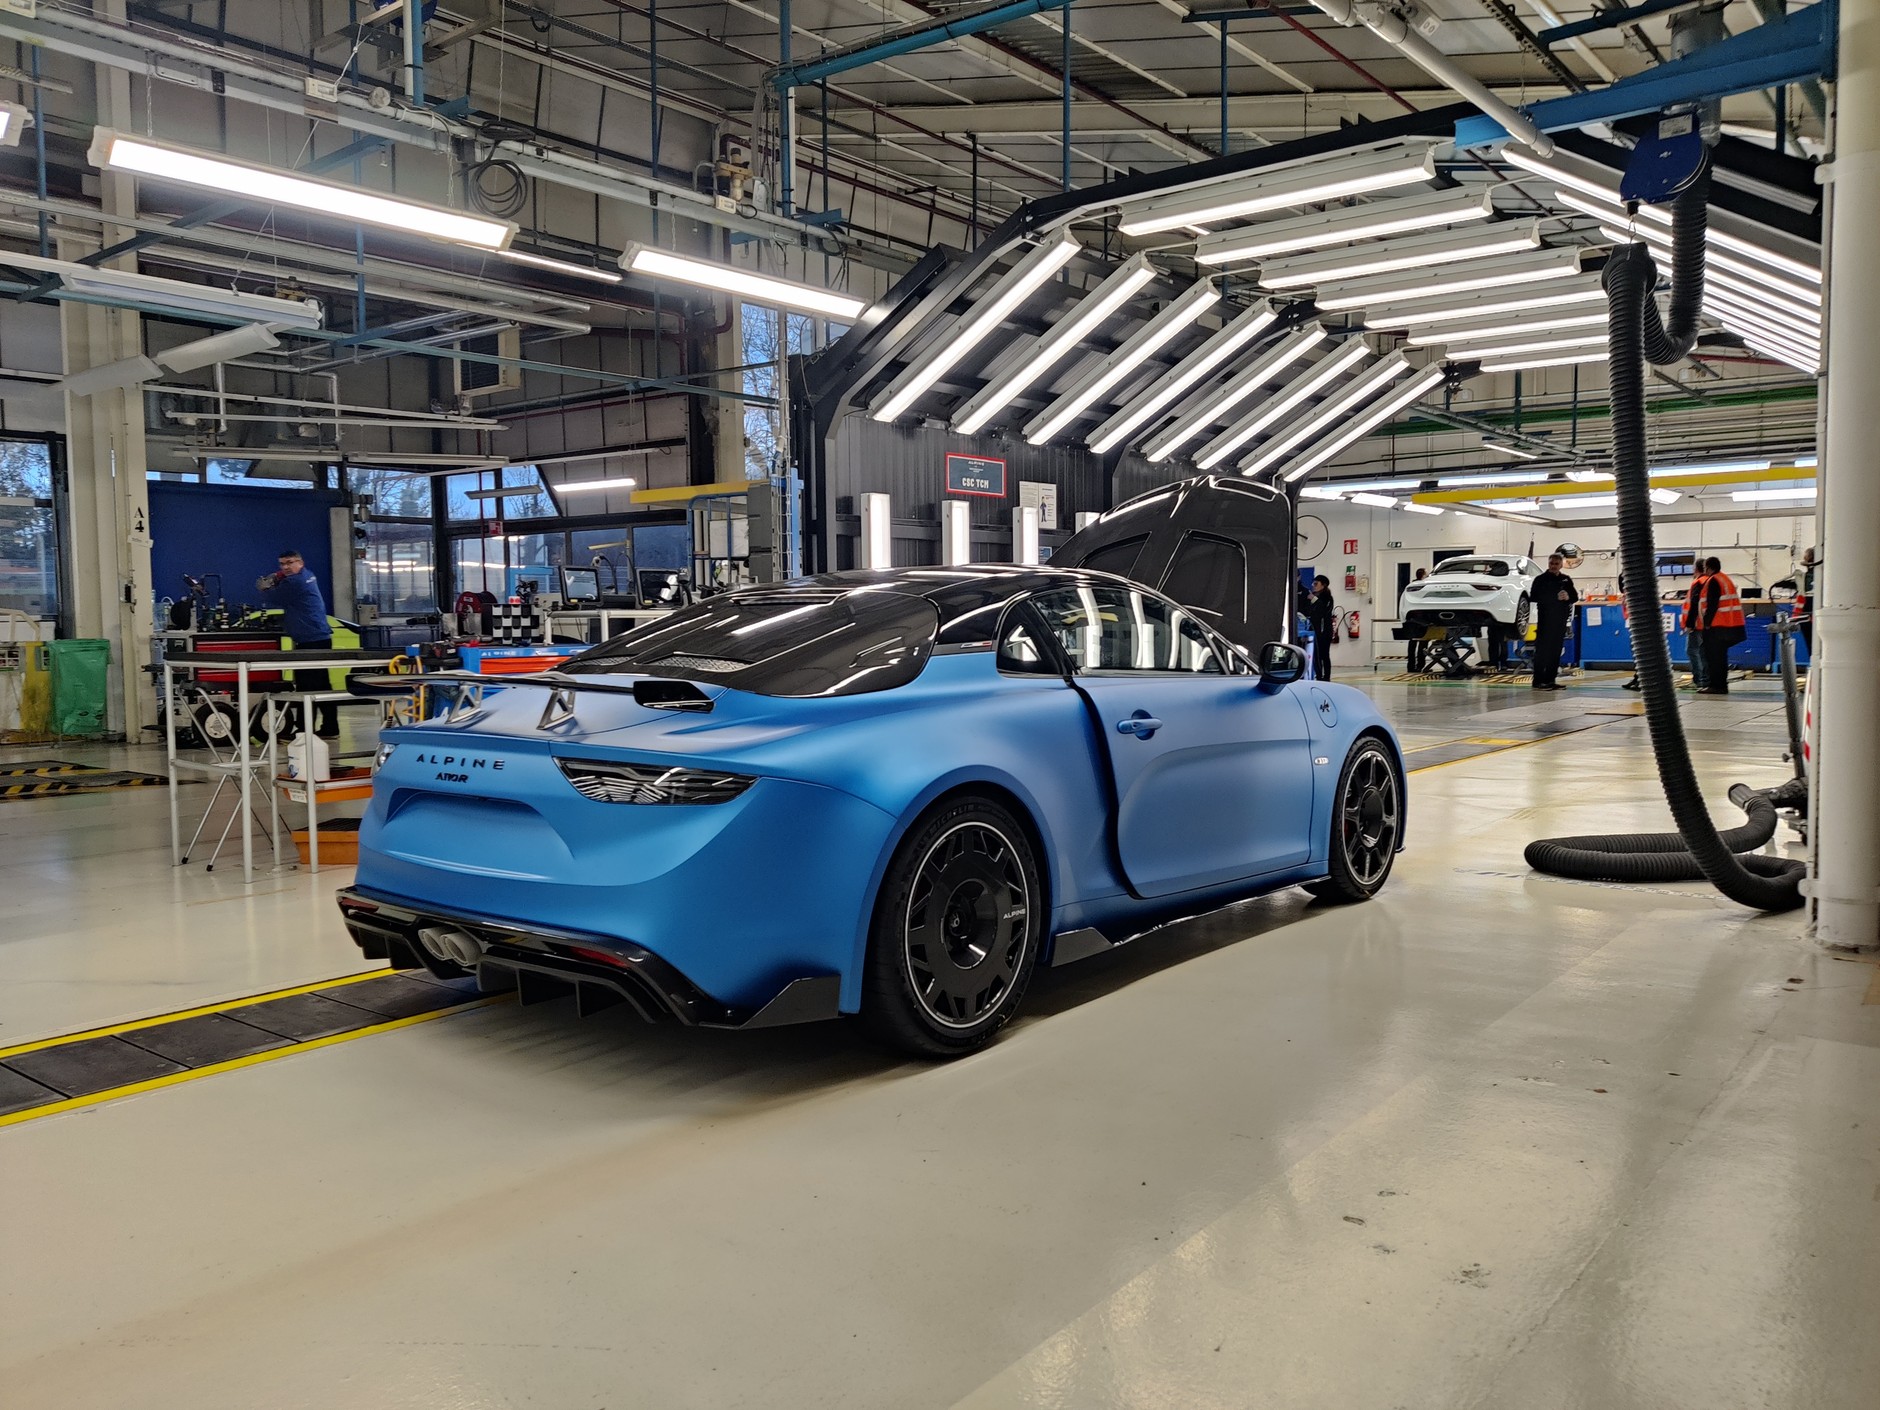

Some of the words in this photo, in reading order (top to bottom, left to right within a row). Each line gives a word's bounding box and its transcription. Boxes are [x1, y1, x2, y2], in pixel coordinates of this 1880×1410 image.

[962, 477, 975, 487] CSC
[133, 506, 145, 519] A
[134, 520, 145, 533] 4
[416, 753, 506, 770] ALPINE
